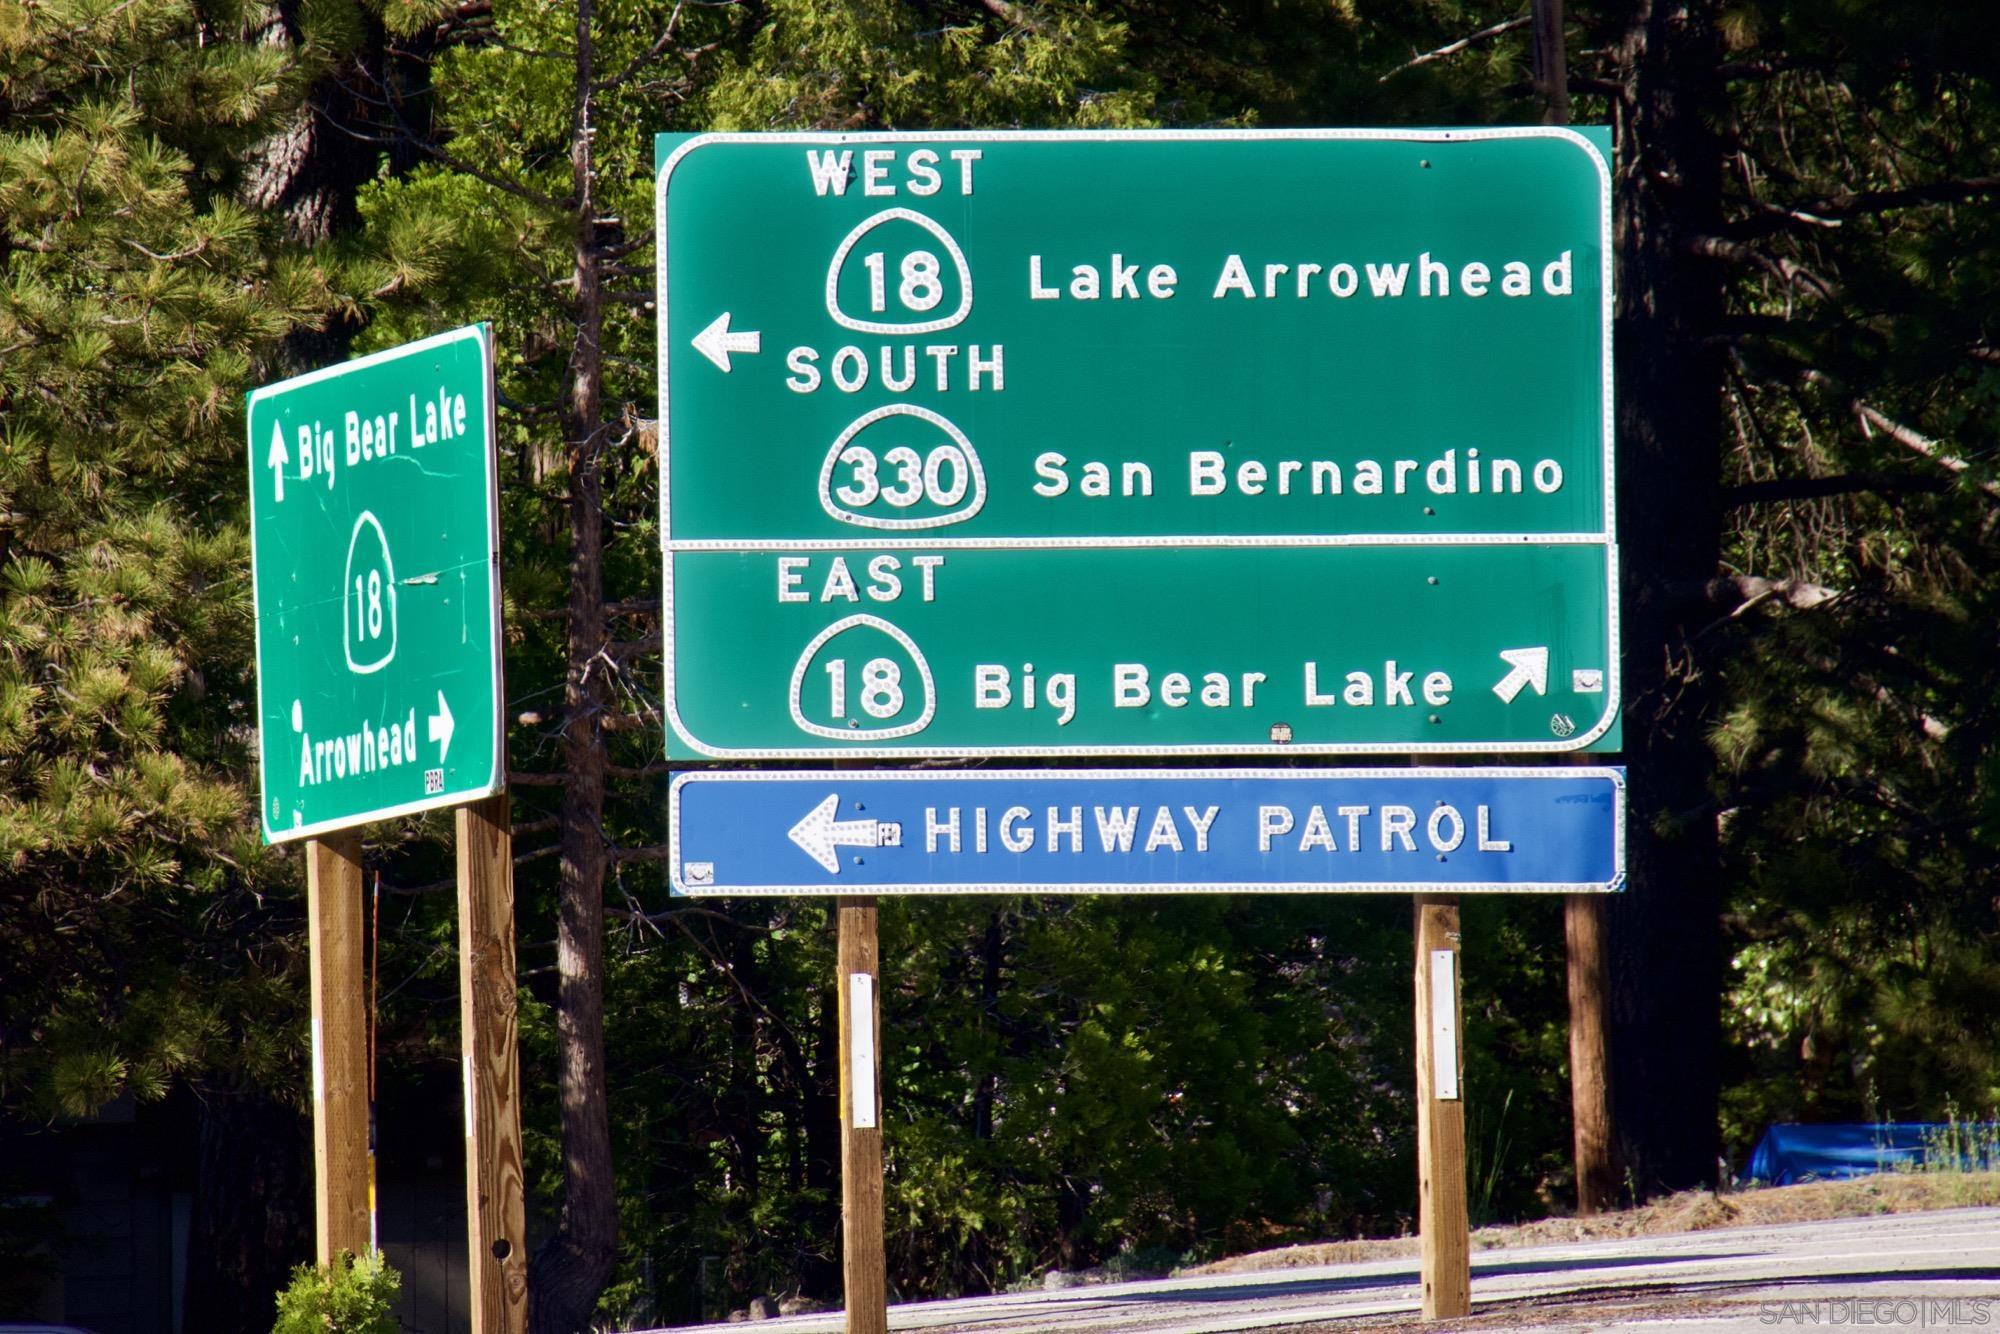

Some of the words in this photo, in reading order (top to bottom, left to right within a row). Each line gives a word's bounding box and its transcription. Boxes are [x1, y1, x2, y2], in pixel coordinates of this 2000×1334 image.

[806, 148, 982, 196] WEST
[864, 250, 943, 312] 18
[1030, 253, 1178, 300] Lake
[1213, 250, 1572, 299] Arrowhead
[786, 344, 1004, 393] SOUTH
[298, 421, 335, 490] Big
[345, 411, 398, 466] Bear
[410, 386, 466, 448] Lake
[836, 445, 969, 507] 330
[1033, 451, 1152, 497] San
[1190, 447, 1563, 496] Bernardino
[355, 569, 382, 641] 18
[778, 554, 944, 603] EAST
[825, 657, 904, 719] 18
[975, 663, 1076, 726] Big
[1114, 663, 1266, 708] Bear
[1304, 660, 1453, 706] Lake
[299, 708, 417, 787] Arrowhead
[925, 805, 1220, 853] HIGHWAY
[1258, 804, 1510, 853] PATROL
